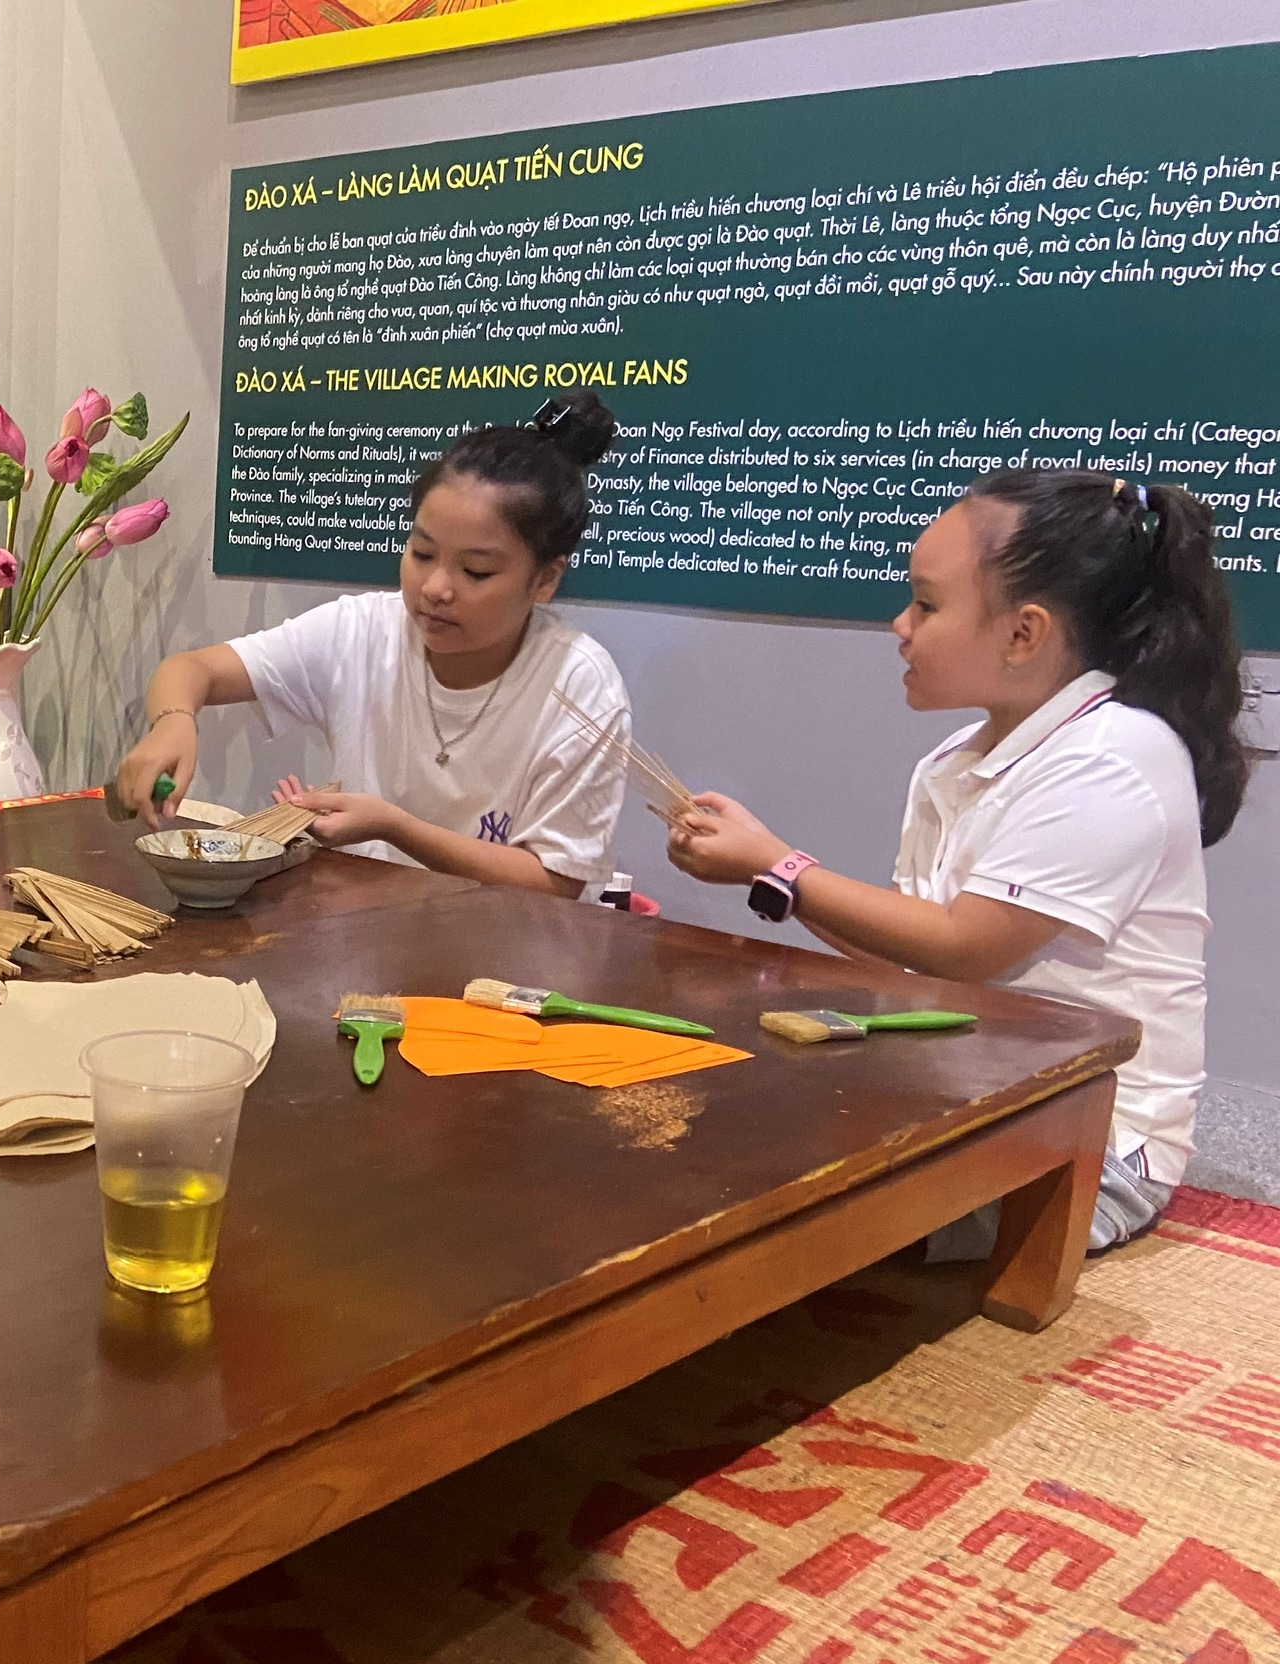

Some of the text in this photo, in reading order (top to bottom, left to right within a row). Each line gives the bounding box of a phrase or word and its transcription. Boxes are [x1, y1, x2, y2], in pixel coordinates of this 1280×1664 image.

[245, 181, 287, 211] ĐÀO
[291, 176, 317, 206] XÁ
[338, 171, 393, 201] LÀNG
[398, 164, 440, 194] LÀM
[446, 158, 509, 190] QUẠT
[514, 144, 563, 181] TIẾN
[569, 142, 644, 175] CUNG
[243, 237, 257, 257] Để
[260, 236, 291, 256] chuẩn
[294, 236, 305, 256] bị
[307, 234, 327, 252] cho
[329, 232, 340, 250] lễ
[342, 232, 364, 249] ban
[367, 231, 393, 251] quạt
[395, 227, 417, 244] của
[420, 223, 446, 242] triều
[449, 220, 477, 239] đình
[480, 220, 504, 236] vào
[507, 217, 540, 238] ngày
[543, 212, 560, 231] tết
[562, 213, 599, 229] Đoan
[639, 202, 666, 226] Lịch
[671, 199, 704, 220] triều
[708, 195, 740, 217] hiến
[745, 192, 806, 215] chương
[811, 187, 843, 211] loại
[847, 183, 874, 205] chí
[876, 184, 897, 202] và
[903, 182, 921, 201] Lê
[926, 176, 966, 198] triều
[971, 175, 1001, 199] hội
[1005, 168, 1046, 193] điển
[1052, 167, 1089, 190] đều
[1202, 155, 1264, 186] phiên
[236, 366, 277, 393] ĐÀO
[280, 365, 306, 392] XÁ
[326, 369, 360, 391] THE
[364, 367, 442, 391] VILLAGE
[447, 364, 538, 389] MAKING
[544, 361, 617, 387] ROYAL
[623, 358, 688, 385] FANS
[234, 422, 245, 436] To
[247, 427, 288, 440] prepare
[291, 421, 306, 437] for
[309, 421, 325, 437] the
[328, 420, 383, 441] fan-giving
[386, 427, 443, 441] ceremony
[446, 424, 459, 437] at
[651, 421, 684, 442] Ngọ
[689, 419, 744, 437] Festival
[748, 418, 781, 443] day,
[787, 418, 870, 443] according
[876, 422, 892, 438] to
[898, 418, 931, 442] Lịch
[937, 418, 977, 438] triều
[983, 418, 1022, 438] hiến
[1029, 418, 1103, 446] chương
[1109, 419, 1148, 445] loại
[1154, 419, 1186, 440] chí
[233, 445, 284, 463] Dictionary
[286, 443, 298, 459] of
[300, 446, 335, 460] Norms
[338, 444, 360, 460] and
[362, 445, 405, 463] Rituals),
[409, 447, 417, 461] it
[419, 451, 442, 461] was
[630, 446, 646, 464] of
[648, 448, 704, 464] Finance
[708, 446, 789, 465] distributed
[793, 451, 809, 466] to
[813, 449, 836, 466] six
[840, 449, 906, 467] services
[912, 449, 933, 470] (in
[939, 448, 1002, 474] charge
[1007, 448, 1029, 469] of
[1158, 460, 1229, 479] money
[1235, 453, 1277, 475] that
[232, 465, 247, 480] the
[249, 467, 270, 480] Đào
[272, 465, 306, 486] family,
[308, 467, 372, 488] specializing
[374, 469, 385, 483] in
[587, 473, 644, 494] Dynasty,
[648, 472, 670, 491] the
[673, 472, 722, 497] village
[726, 473, 799, 498] belonged
[802, 479, 818, 494] to
[822, 477, 868, 500] Ngọc
[873, 477, 906, 500] Cục
[230, 488, 274, 503] Province.
[279, 488, 297, 504] The
[345, 490, 386, 511] tutelary
[389, 495, 412, 511] god
[617, 498, 645, 516] Tiến
[700, 500, 725, 518] The
[731, 501, 782, 525] village
[787, 507, 813, 521] not
[817, 503, 854, 528] only
[858, 505, 941, 529] produced
[230, 508, 890, 557] techniques, could make valuable precious wood) dedicated to the king,
[228, 529, 272, 550] founding
[274, 533, 302, 552] Hàng
[304, 534, 332, 552] Quạt
[334, 536, 365, 551] Street
[366, 537, 389, 553] and
[584, 549, 613, 568] Fan)
[617, 550, 664, 572] Temple
[667, 551, 740, 573] dedicated
[744, 559, 758, 574] to
[763, 556, 798, 576] their
[801, 558, 839, 578] craft
